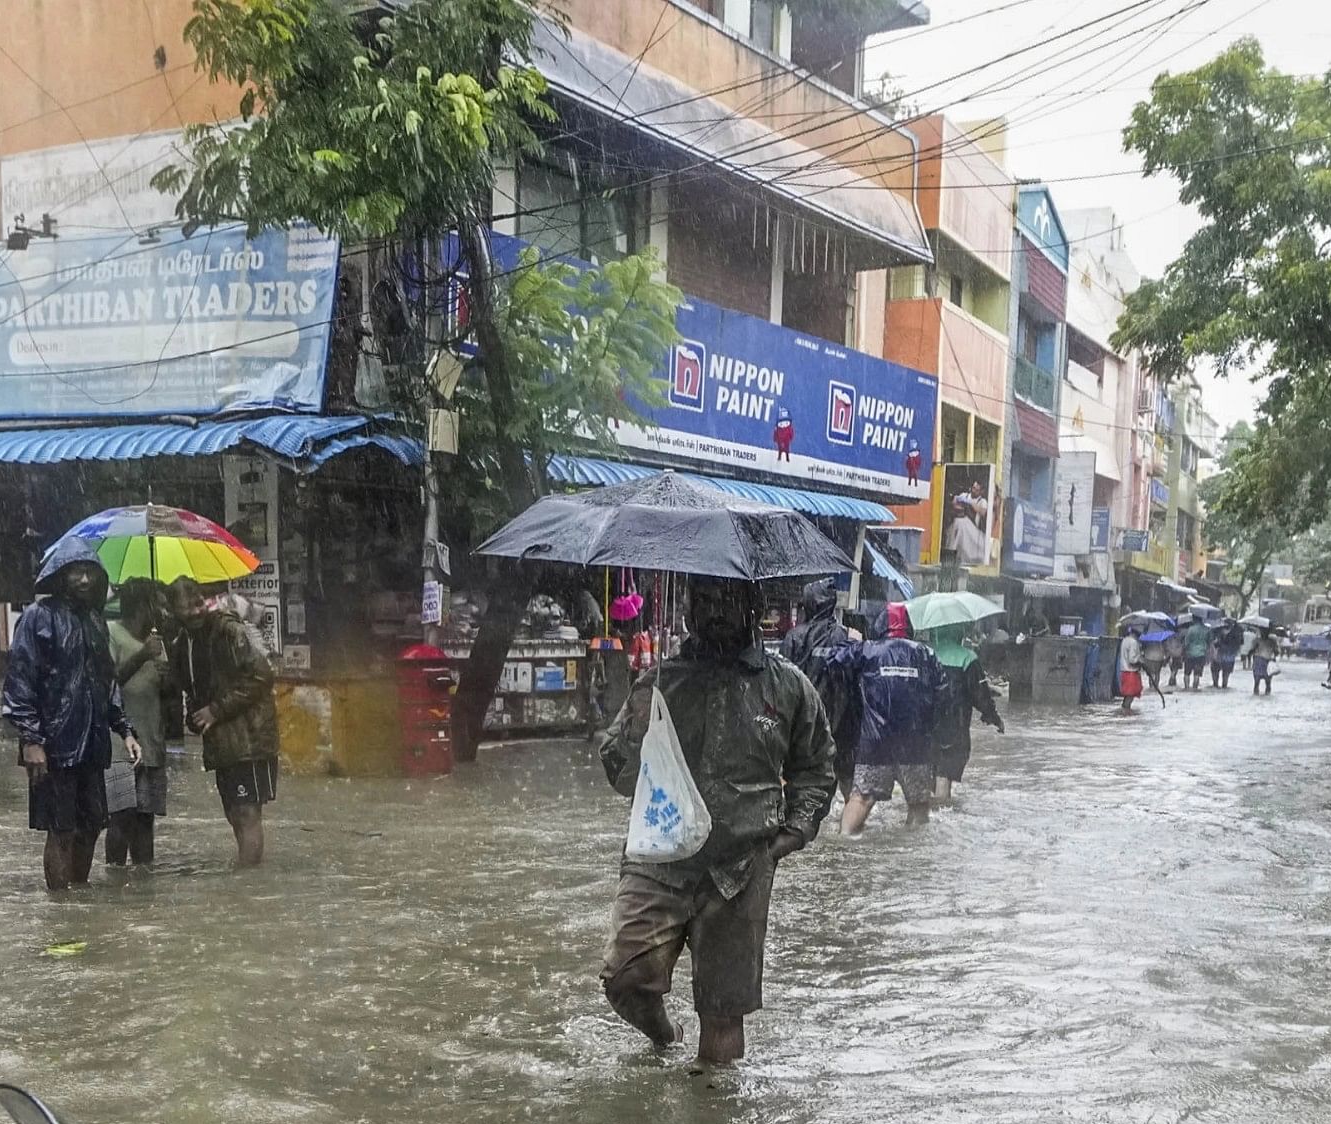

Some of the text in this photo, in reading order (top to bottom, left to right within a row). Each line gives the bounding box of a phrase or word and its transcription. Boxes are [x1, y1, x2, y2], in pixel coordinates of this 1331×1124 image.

[163, 279, 318, 319] TRADERS
[708, 353, 784, 397] NIPPON
[716, 386, 775, 423] PAINT
[858, 395, 915, 430] NIPPON
[699, 443, 757, 462] PARTHIBAN TRADERS
[862, 422, 907, 453] PAINT
[231, 576, 278, 589] Exterior
